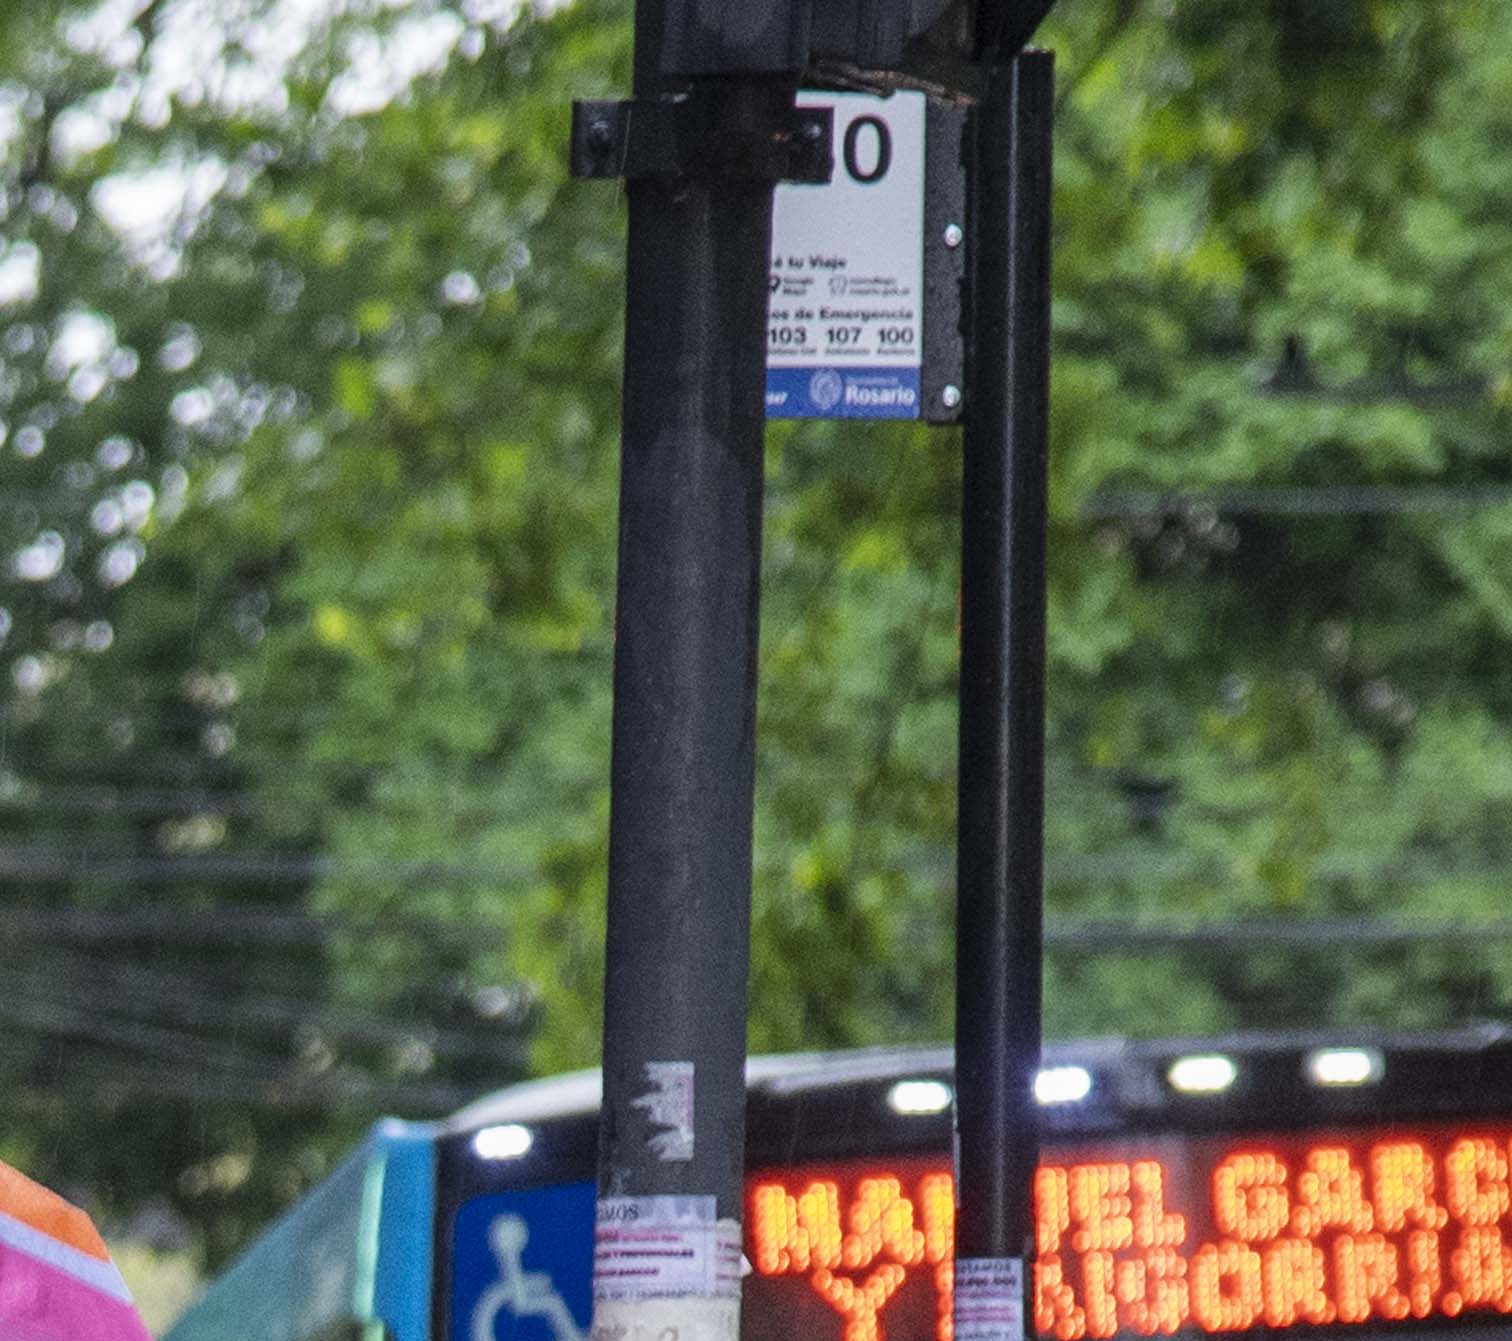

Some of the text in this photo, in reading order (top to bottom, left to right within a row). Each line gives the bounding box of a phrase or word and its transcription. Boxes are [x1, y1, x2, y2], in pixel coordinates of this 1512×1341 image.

[819, 306, 914, 322] Emergencia
[770, 326, 914, 344] 103 107 100
[845, 385, 916, 406] Rosario
